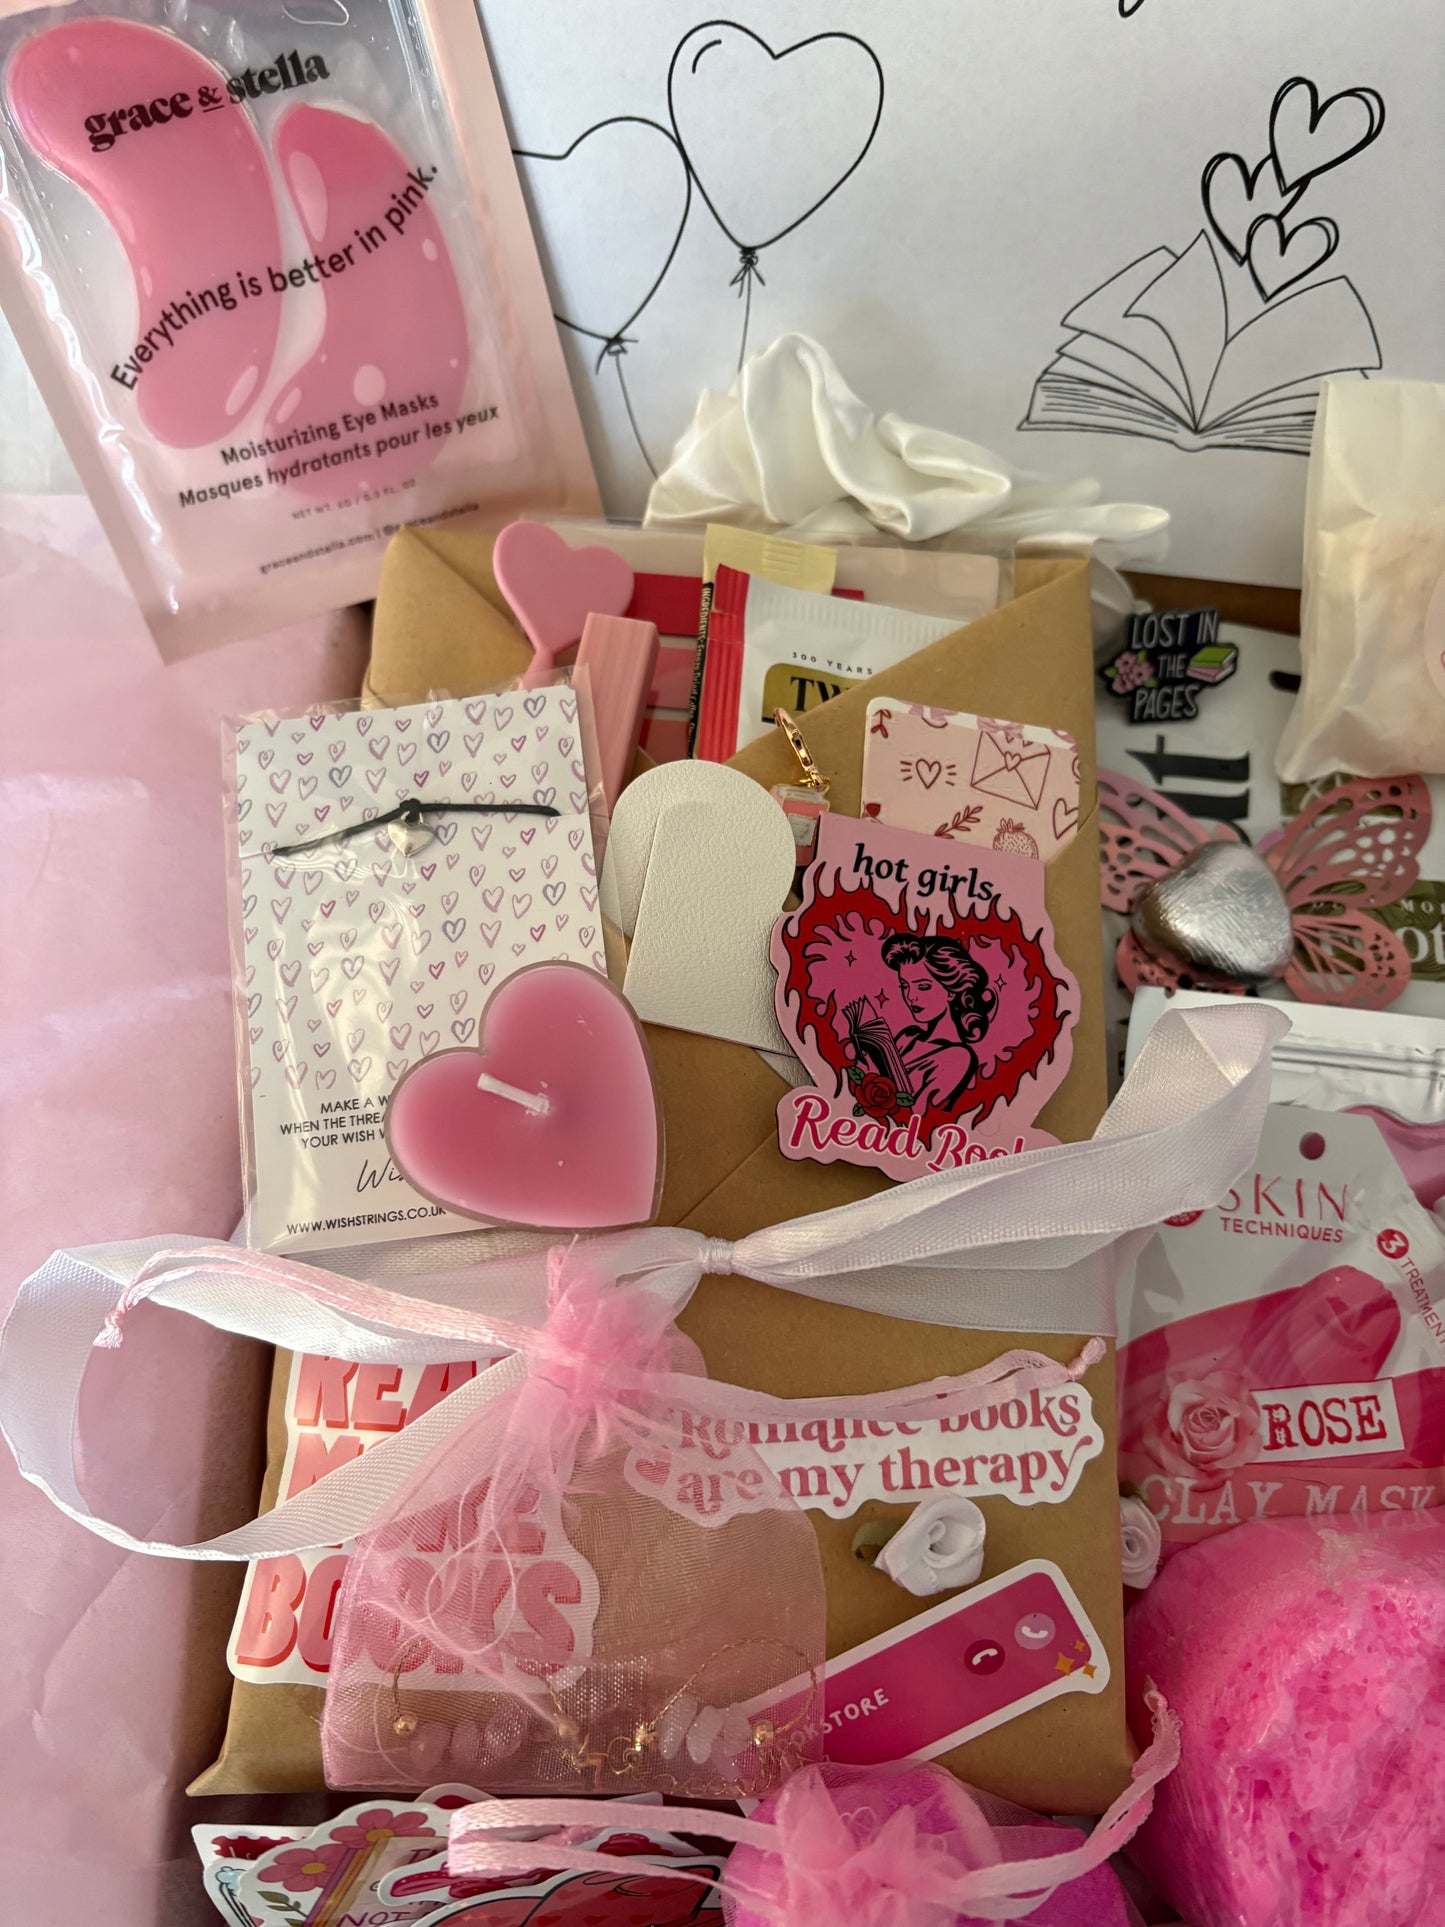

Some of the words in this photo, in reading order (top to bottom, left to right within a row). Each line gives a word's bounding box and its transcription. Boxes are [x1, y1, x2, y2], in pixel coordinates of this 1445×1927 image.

[83, 88, 194, 153] grace
[197, 84, 223, 112] &
[226, 49, 330, 104] stella
[110, 282, 238, 391] Everything
[236, 271, 263, 298] is
[267, 244, 355, 293] better
[354, 229, 387, 254] in
[384, 166, 438, 236] pink.
[220, 421, 341, 466] Moisturizing
[342, 411, 377, 435] Eye
[380, 393, 439, 421] Masks
[179, 472, 263, 509] Masques
[267, 443, 372, 486] hydratants
[376, 428, 421, 459] pour
[424, 419, 453, 440] les
[455, 404, 500, 435] yeux
[1131, 612, 1191, 650] LOST
[1195, 609, 1219, 645] IN
[791, 651, 817, 663] 300
[826, 659, 873, 675] YEARS
[1157, 653, 1188, 680] THE
[1133, 685, 1200, 721] PAGES
[852, 843, 909, 883] hot
[917, 865, 994, 902] girls
[279, 1120, 320, 1136] WHEN
[323, 1117, 347, 1130] THE
[349, 1111, 386, 1127] THRE
[320, 1098, 360, 1114] MAKE
[363, 1096, 375, 1109] A
[789, 1094, 922, 1159] Read
[301, 1133, 338, 1149] YOUR
[342, 1129, 375, 1144] WISH
[1219, 1216, 1344, 1244] TECHNIQUES
[1262, 1393, 1388, 1452] ROSE
[676, 1468, 764, 1516] are
[776, 1464, 865, 1508] my
[878, 1435, 1094, 1499] therapy
[1139, 1473, 1283, 1526] CLAY
